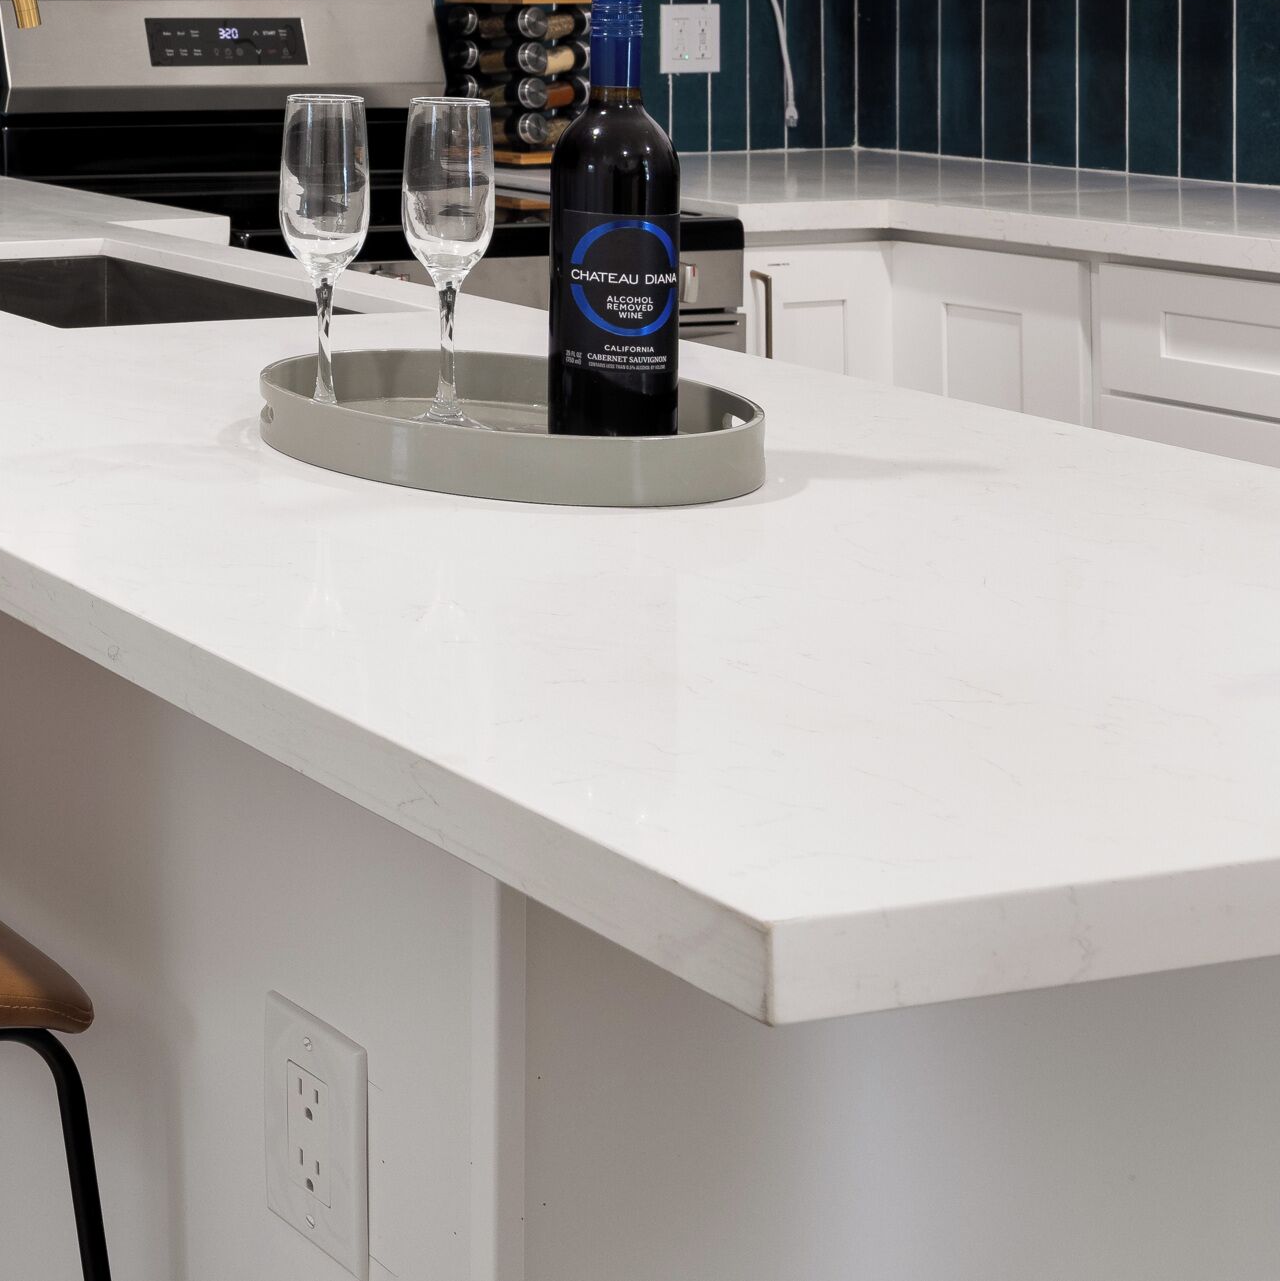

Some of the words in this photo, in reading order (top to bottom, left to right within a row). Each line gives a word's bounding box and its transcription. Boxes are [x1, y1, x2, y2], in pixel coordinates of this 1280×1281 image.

[571, 269, 638, 284] CHATEAU
[645, 273, 676, 284] DIANA
[606, 295, 654, 304] ALCOHOL
[606, 303, 654, 312] REMOVED
[618, 311, 644, 319] WINE
[604, 344, 655, 353] CALIFORNIA
[587, 352, 628, 363] CABERNET
[629, 355, 667, 363] SAUVIGNON
